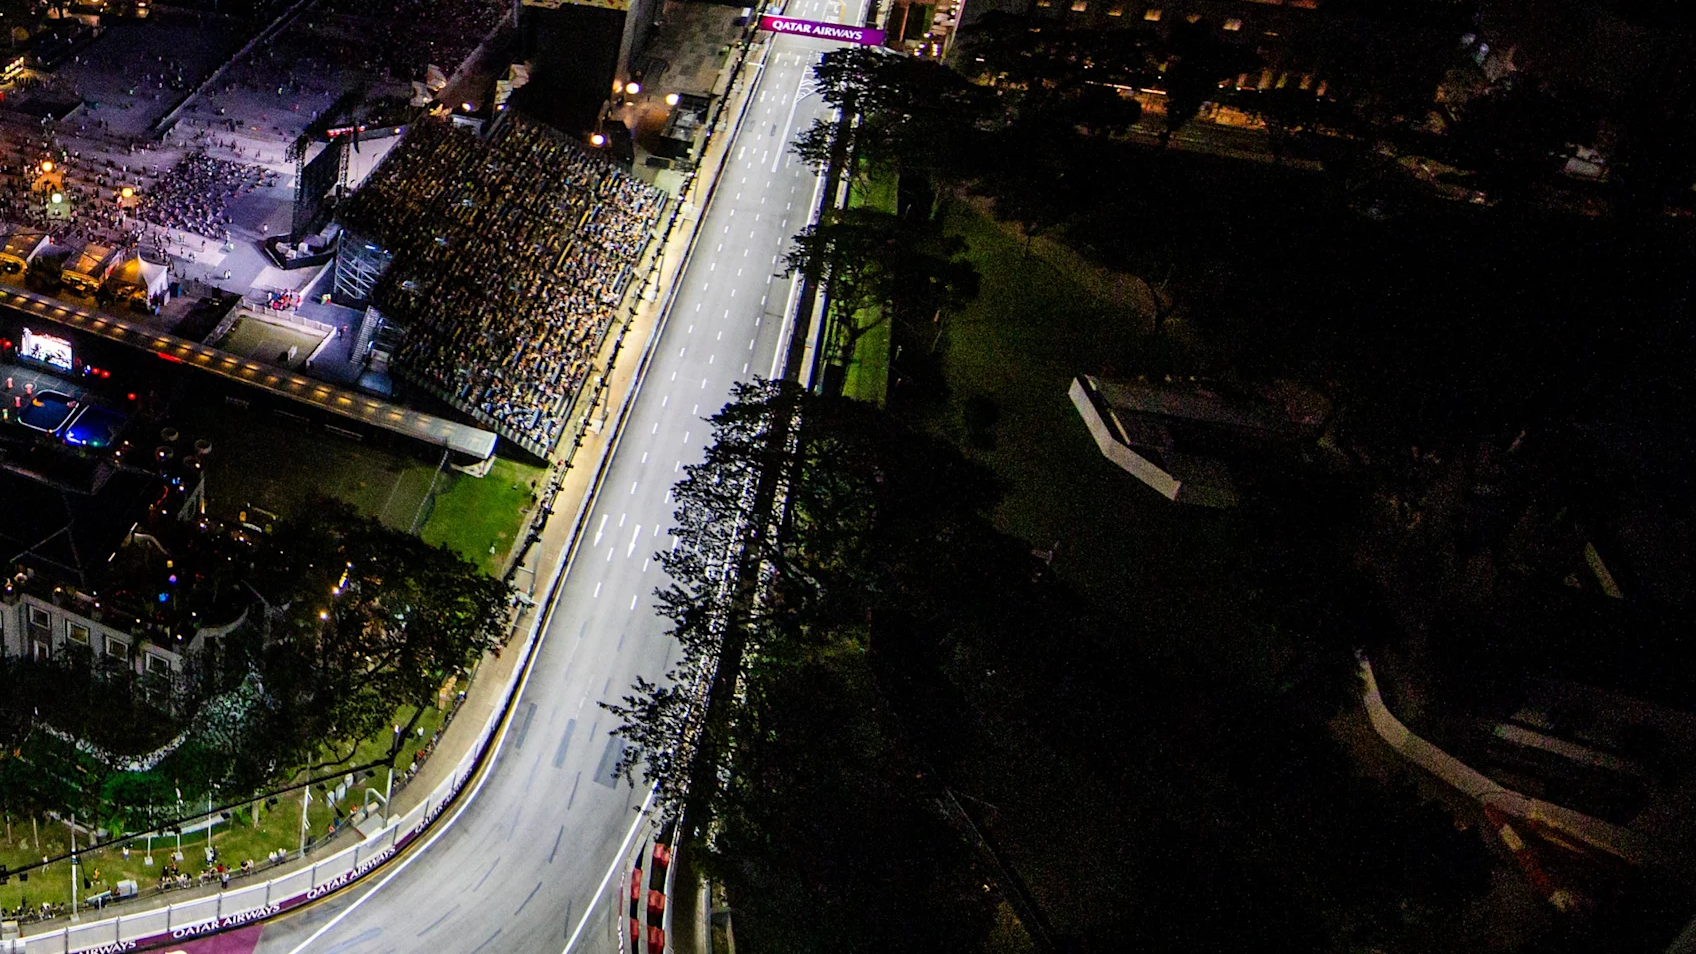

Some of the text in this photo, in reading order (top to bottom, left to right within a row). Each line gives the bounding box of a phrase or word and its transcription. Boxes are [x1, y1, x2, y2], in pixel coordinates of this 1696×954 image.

[772, 20, 863, 40] QATAR AIRWAYS
[307, 848, 395, 900] QATAR AIRWAYS
[173, 903, 280, 939] QATAR AIRWAYS
